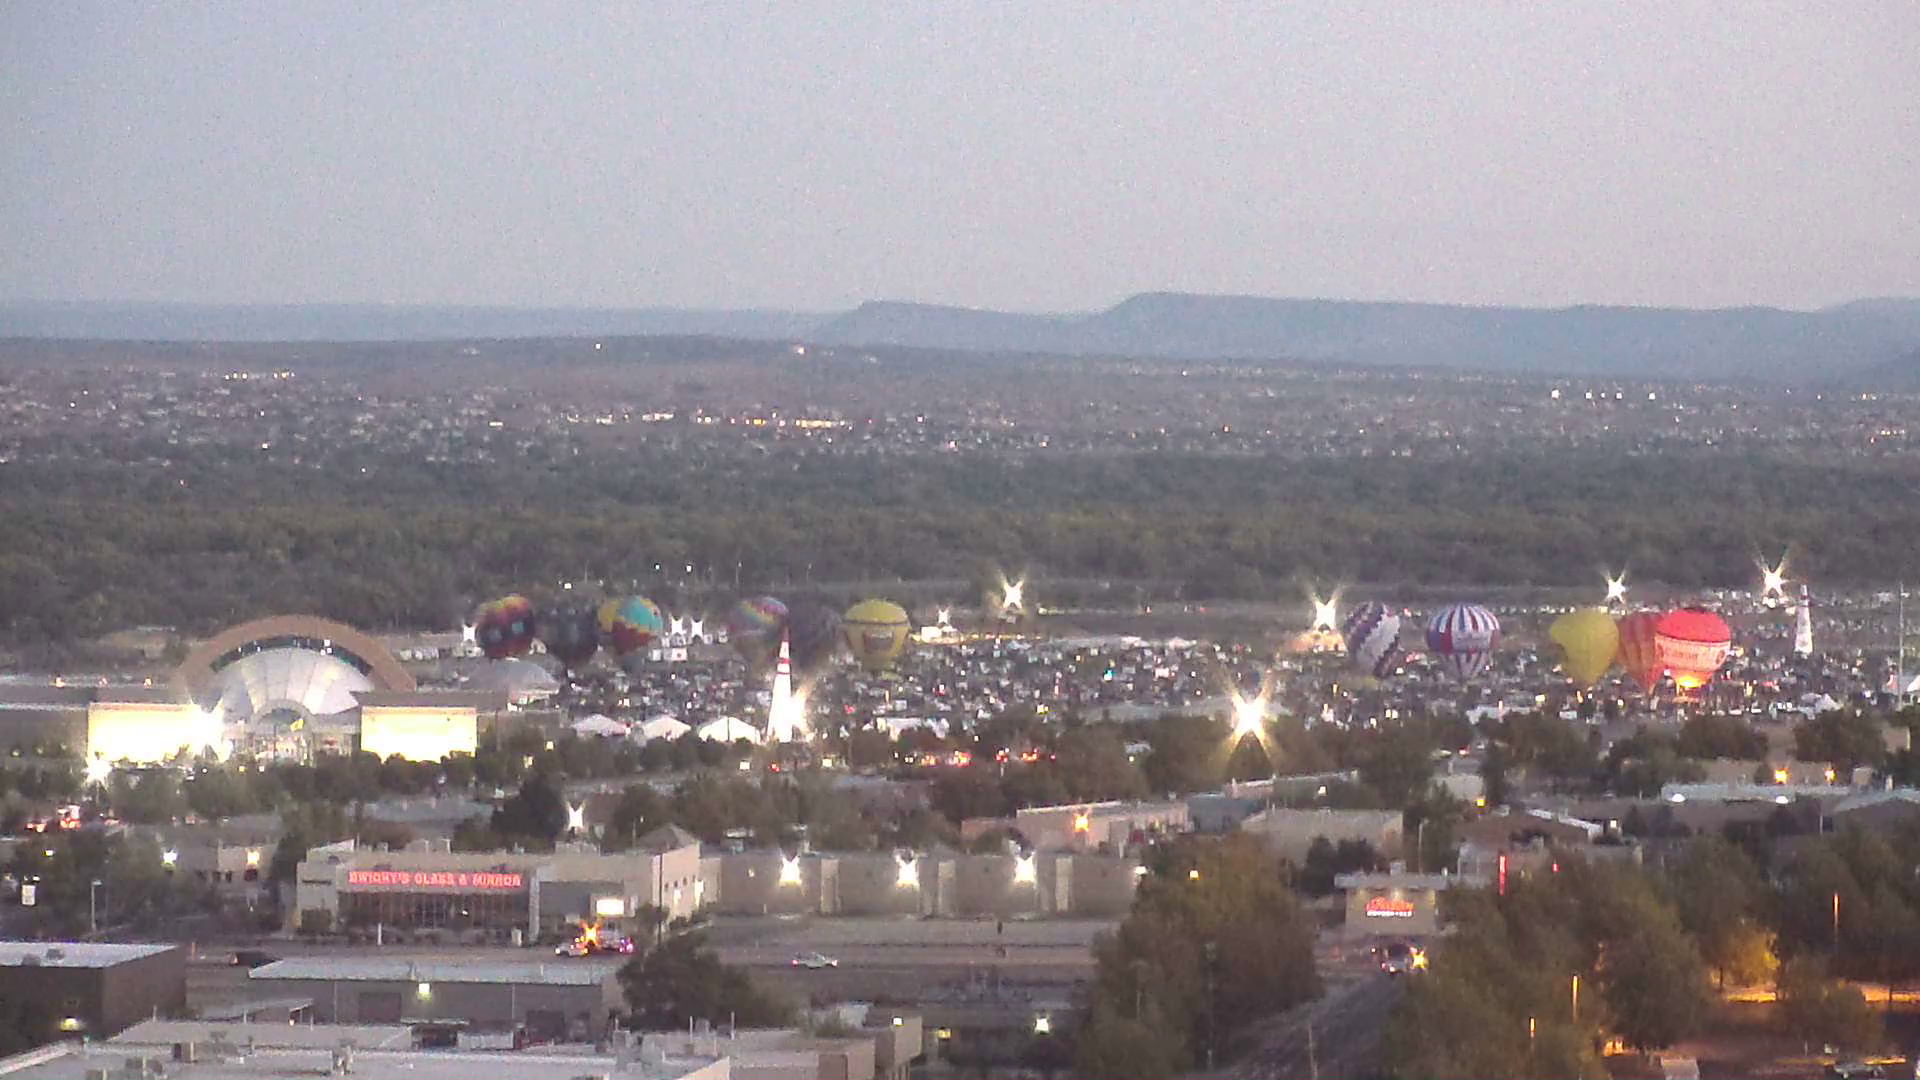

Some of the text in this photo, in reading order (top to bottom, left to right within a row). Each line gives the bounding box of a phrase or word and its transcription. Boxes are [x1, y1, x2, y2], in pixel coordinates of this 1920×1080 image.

[414, 872, 455, 886] GLASS
[458, 873, 467, 886] &
[472, 873, 522, 887] MIRROR
